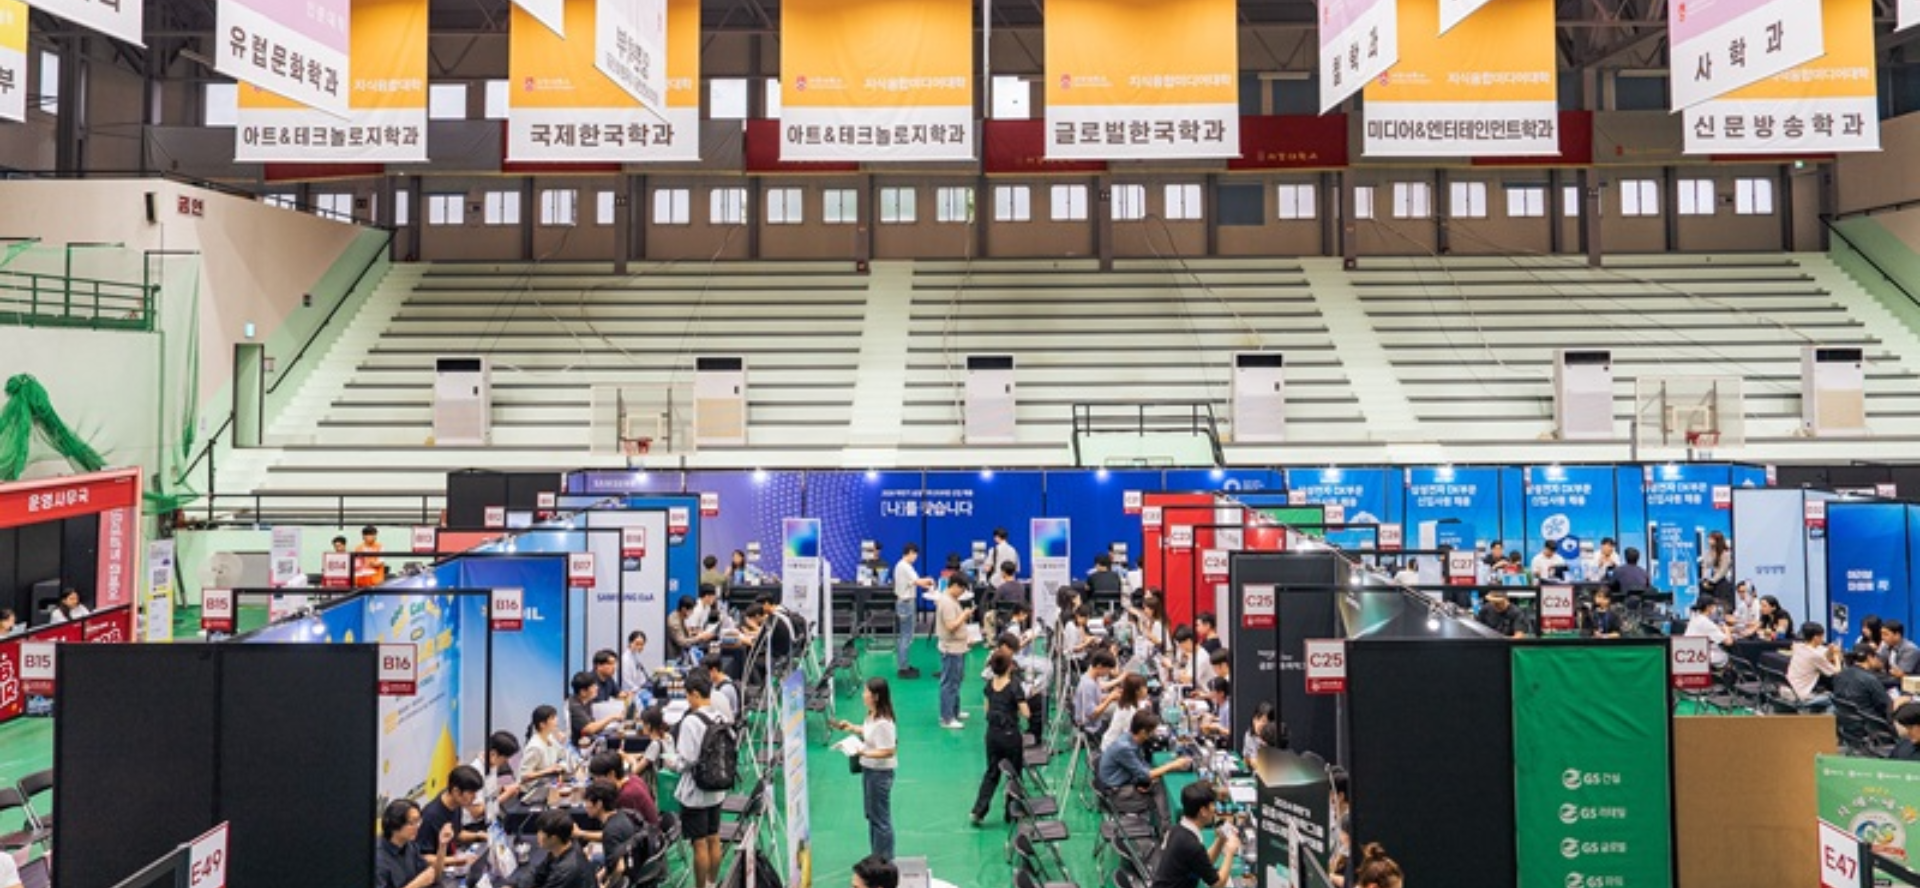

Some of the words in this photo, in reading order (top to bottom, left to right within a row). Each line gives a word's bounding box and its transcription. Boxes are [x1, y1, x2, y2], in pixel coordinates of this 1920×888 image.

[229, 25, 340, 97] 유럽문화학과
[243, 125, 420, 147] 아트&테크놀로지학과
[530, 123, 675, 148] 국제한국학과
[787, 124, 966, 146] 아트&테크놀로지학과
[1055, 120, 1227, 145] 글로벌한국학과
[1367, 119, 1554, 140] 미디어&엔터테인먼트학과
[28, 487, 90, 512] 운영사무국
[1204, 556, 1228, 567] C24
[1451, 558, 1473, 569] C27
[206, 597, 228, 610] B15
[495, 598, 519, 611] B16
[1245, 595, 1274, 608] C25
[1543, 596, 1571, 608] C26
[24, 655, 51, 668] B15
[383, 656, 411, 671] B16
[1309, 652, 1343, 668] C25
[1674, 650, 1707, 664] C26
[1583, 771, 1600, 785] GS
[1580, 806, 1597, 819] GS
[1581, 841, 1599, 854] GS
[191, 848, 222, 887] E49
[1824, 844, 1858, 880] E47
[1586, 875, 1603, 888] GS
